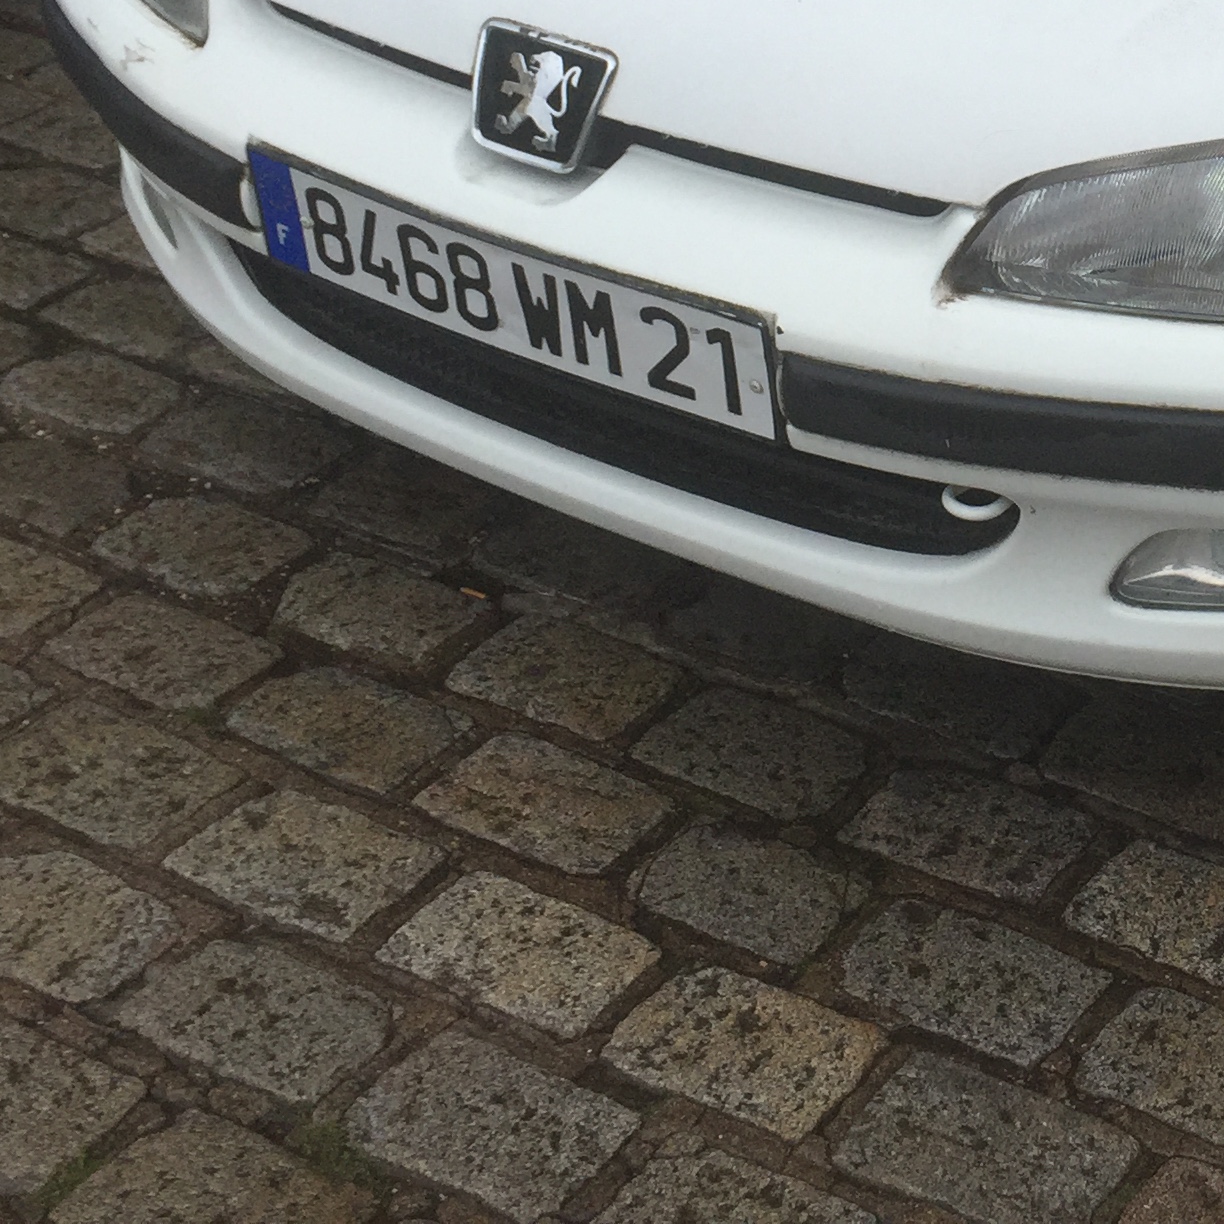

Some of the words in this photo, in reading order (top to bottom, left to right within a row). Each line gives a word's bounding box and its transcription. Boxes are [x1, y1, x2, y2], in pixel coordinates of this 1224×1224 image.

[275, 222, 290, 247] F
[305, 187, 499, 332] 8468
[511, 261, 622, 376] WM
[638, 306, 743, 415] 21
